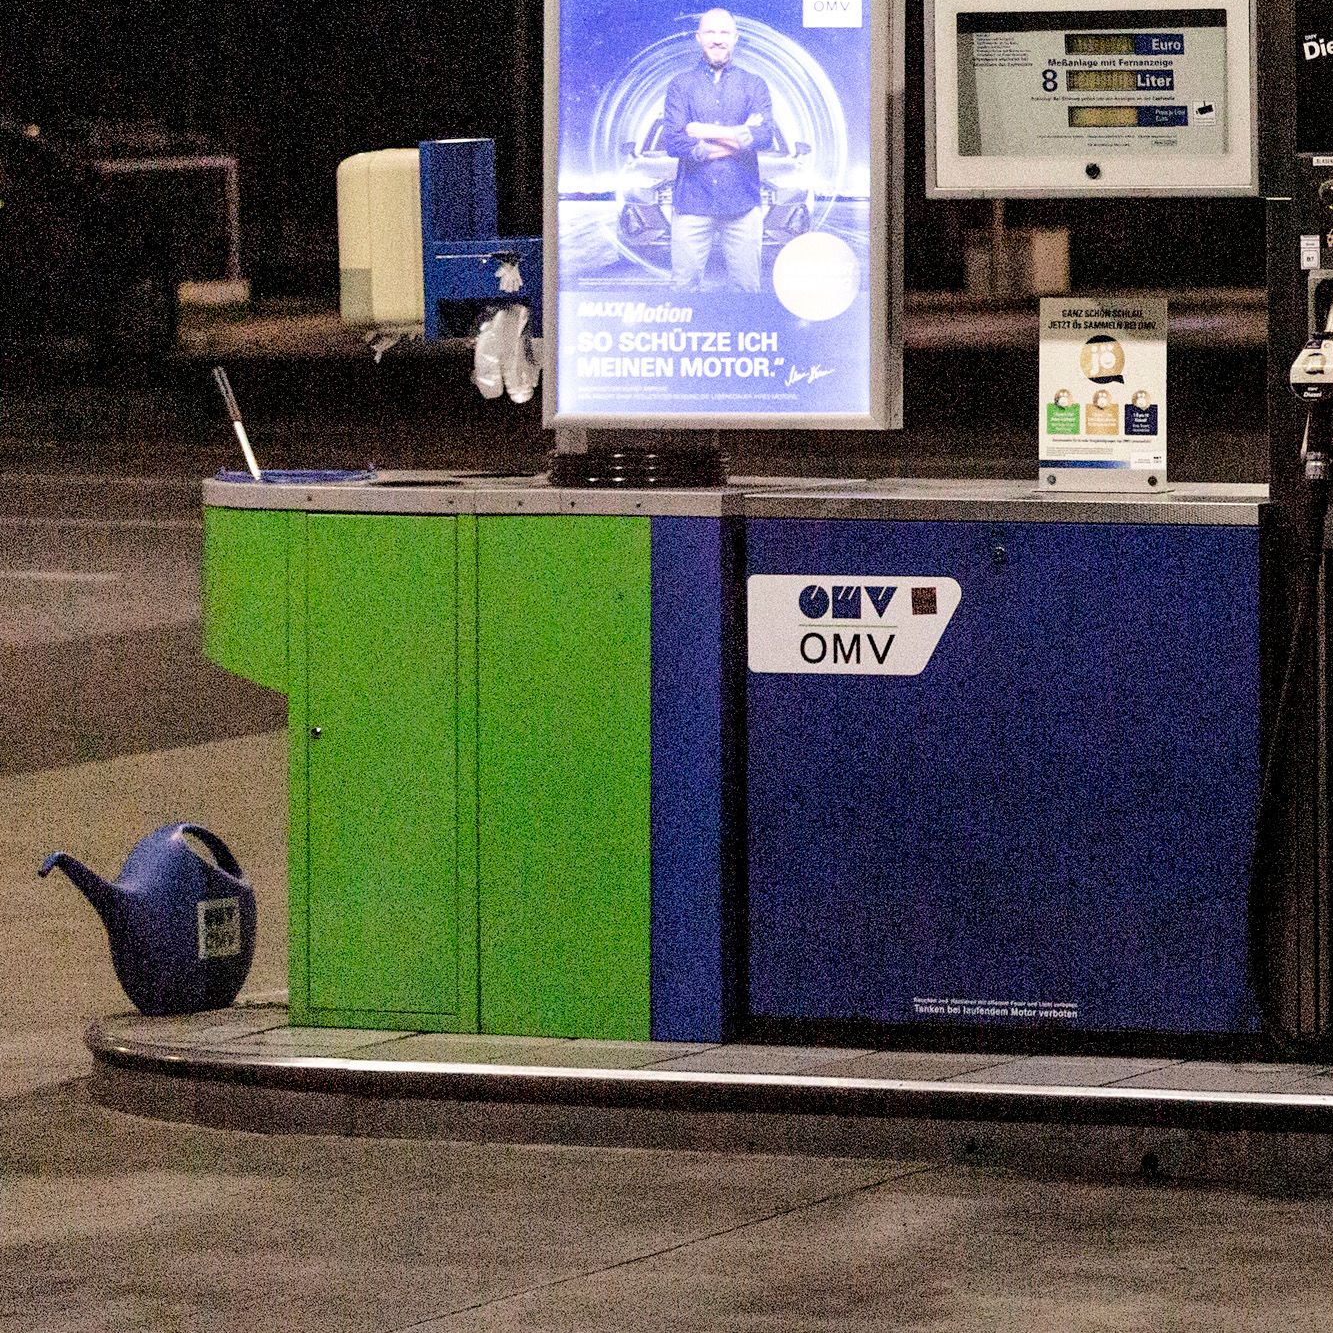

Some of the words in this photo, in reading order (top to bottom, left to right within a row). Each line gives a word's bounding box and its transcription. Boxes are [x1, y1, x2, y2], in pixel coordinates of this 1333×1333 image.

[813, 0, 850, 12] OMV
[1151, 37, 1182, 52] Euro
[1041, 69, 1058, 93] 8
[1137, 74, 1172, 88] Liter
[618, 327, 732, 353] SCHÜTZE
[738, 331, 778, 353] ICH
[576, 357, 674, 378] MEINEN
[800, 632, 895, 664] OMV
[914, 1004, 945, 1014] Tanken
[947, 1005, 961, 1014] bei
[1010, 1007, 1036, 1017] Motor
